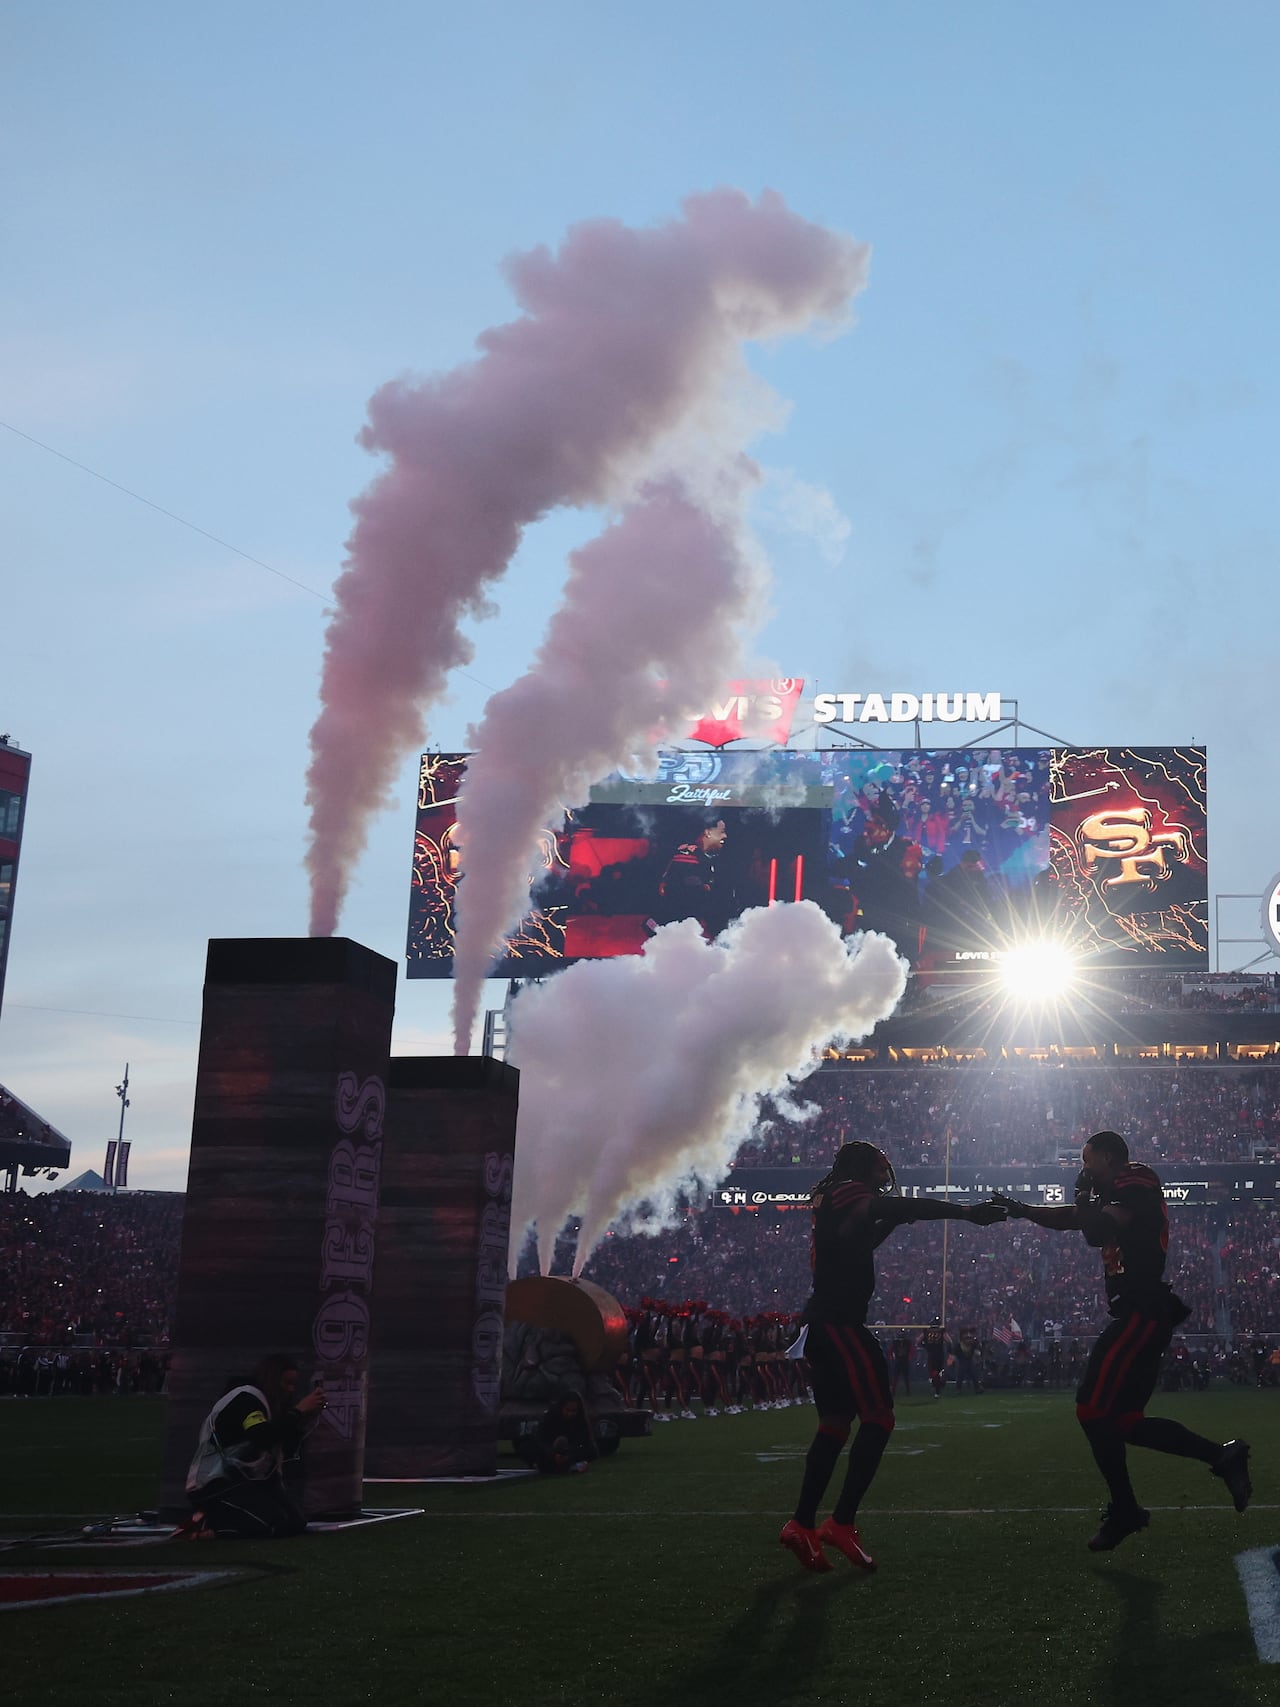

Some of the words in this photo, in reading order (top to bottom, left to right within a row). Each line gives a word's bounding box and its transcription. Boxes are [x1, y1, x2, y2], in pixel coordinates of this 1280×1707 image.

[813, 692, 1002, 724] STADIUM
[1046, 1188, 1062, 1201] 25
[1160, 1186, 1189, 1201] inity
[311, 1069, 386, 1441] 49ERS
